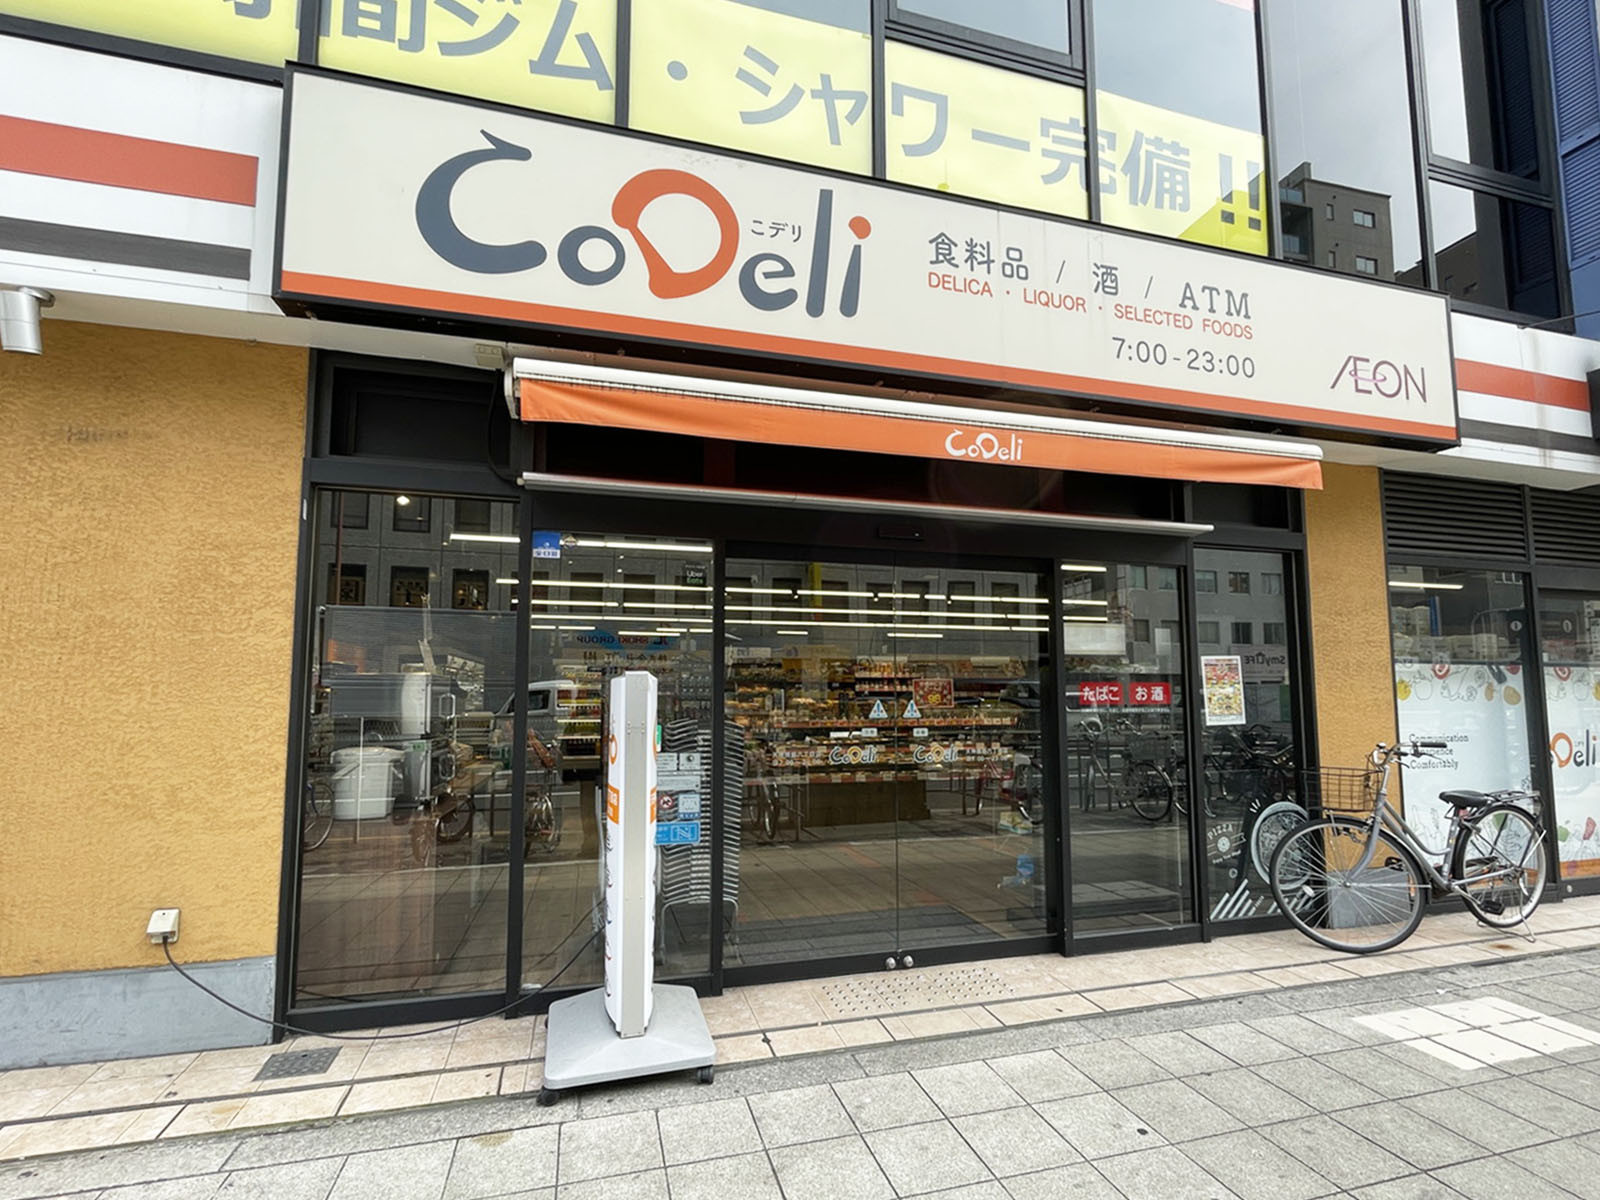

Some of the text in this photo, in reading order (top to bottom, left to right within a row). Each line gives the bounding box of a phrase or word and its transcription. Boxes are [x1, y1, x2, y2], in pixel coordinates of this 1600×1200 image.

[415, 129, 872, 318] CoDeli
[751, 219, 802, 243] こデリ
[928, 231, 1029, 281] 食料品
[1091, 262, 1119, 296] 酒
[1178, 281, 1252, 320] ATM
[927, 271, 994, 298] DELICA
[1022, 287, 1087, 313] LIQUOR
[1113, 303, 1193, 330] SELECTED
[1202, 317, 1254, 340] FOODS
[944, 428, 1024, 461] CoDeli
[686, 570, 704, 578] Uber
[1082, 685, 1164, 702] たばこ お酒
[1549, 728, 1597, 768] Deli
[1207, 823, 1234, 841] PIZZA
